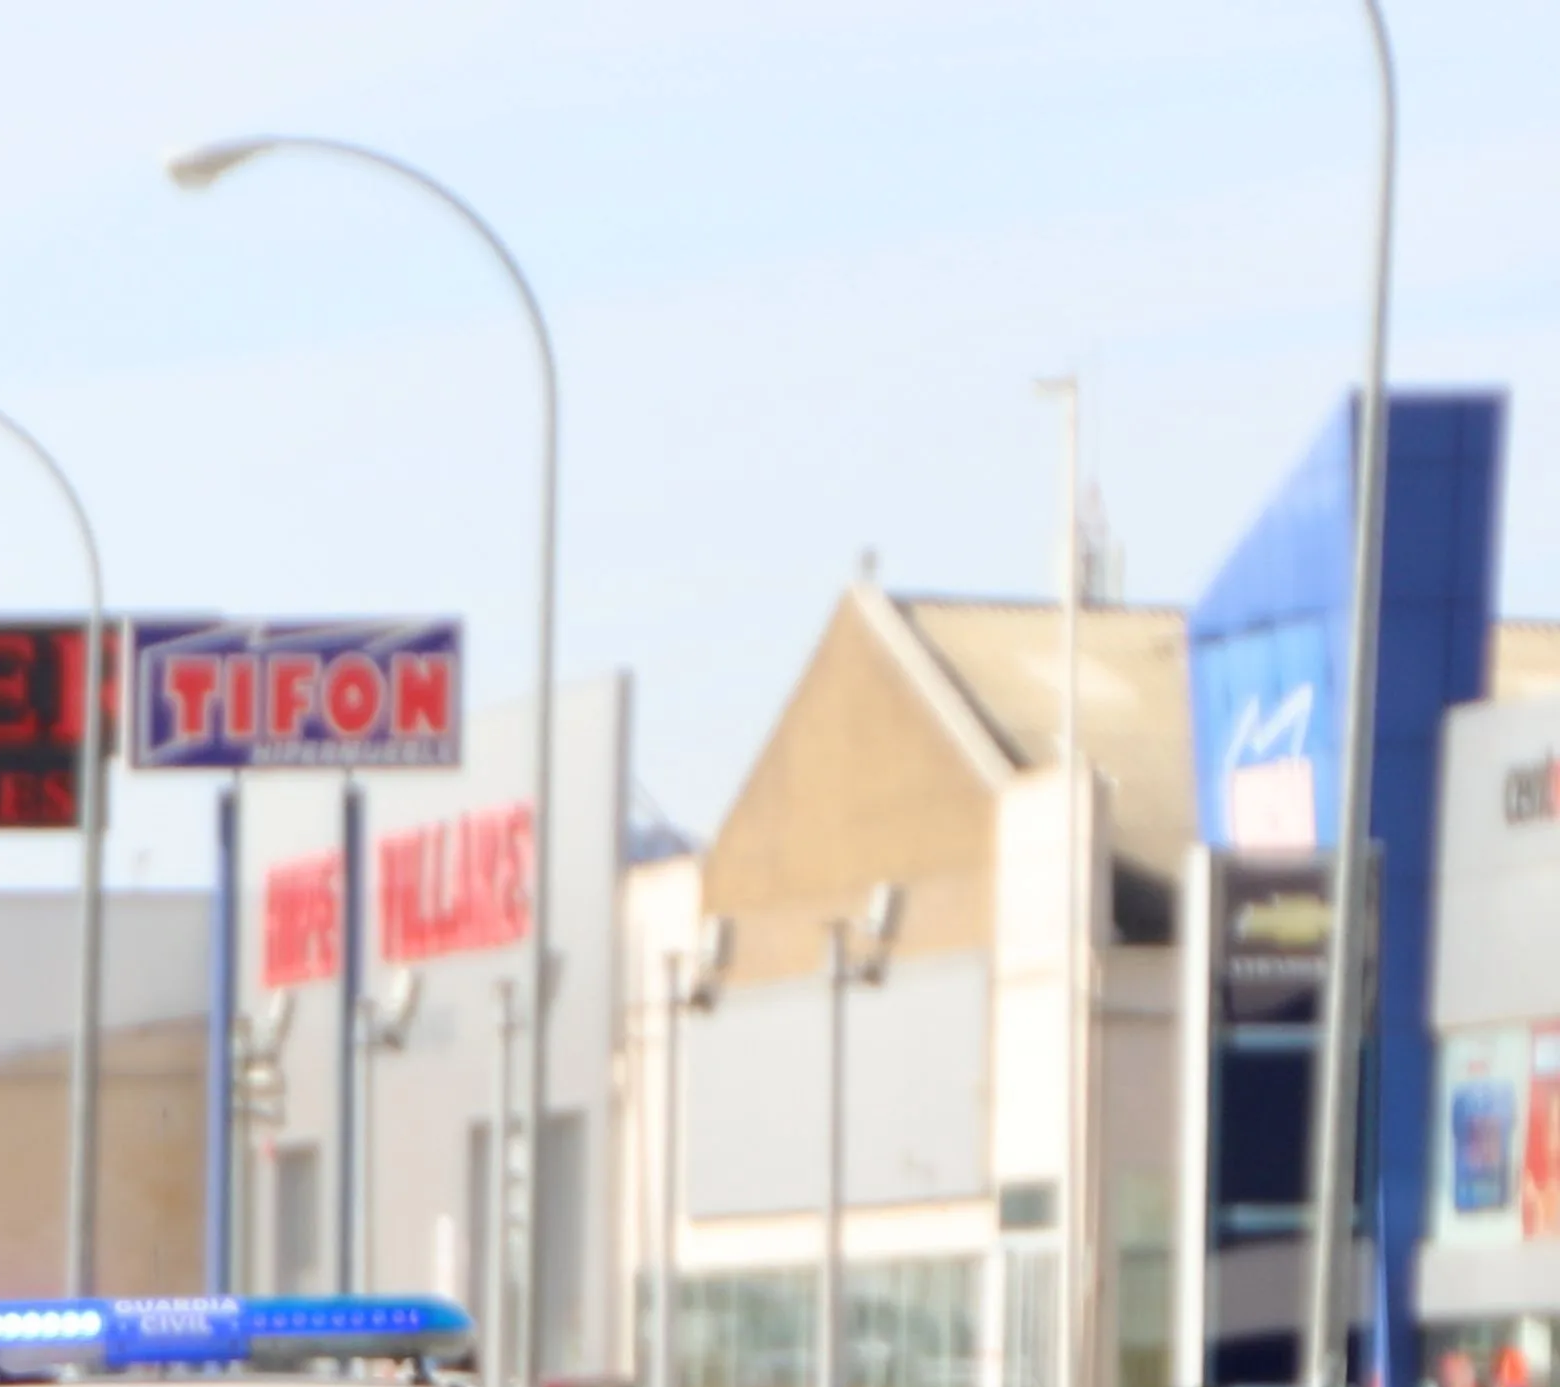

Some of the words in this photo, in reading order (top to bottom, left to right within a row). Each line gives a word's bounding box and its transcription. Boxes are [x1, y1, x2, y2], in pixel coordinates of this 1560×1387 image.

[165, 652, 456, 741] TIFON
[114, 1298, 239, 1314] GUARDIA
[139, 1312, 213, 1336] CIVIL
